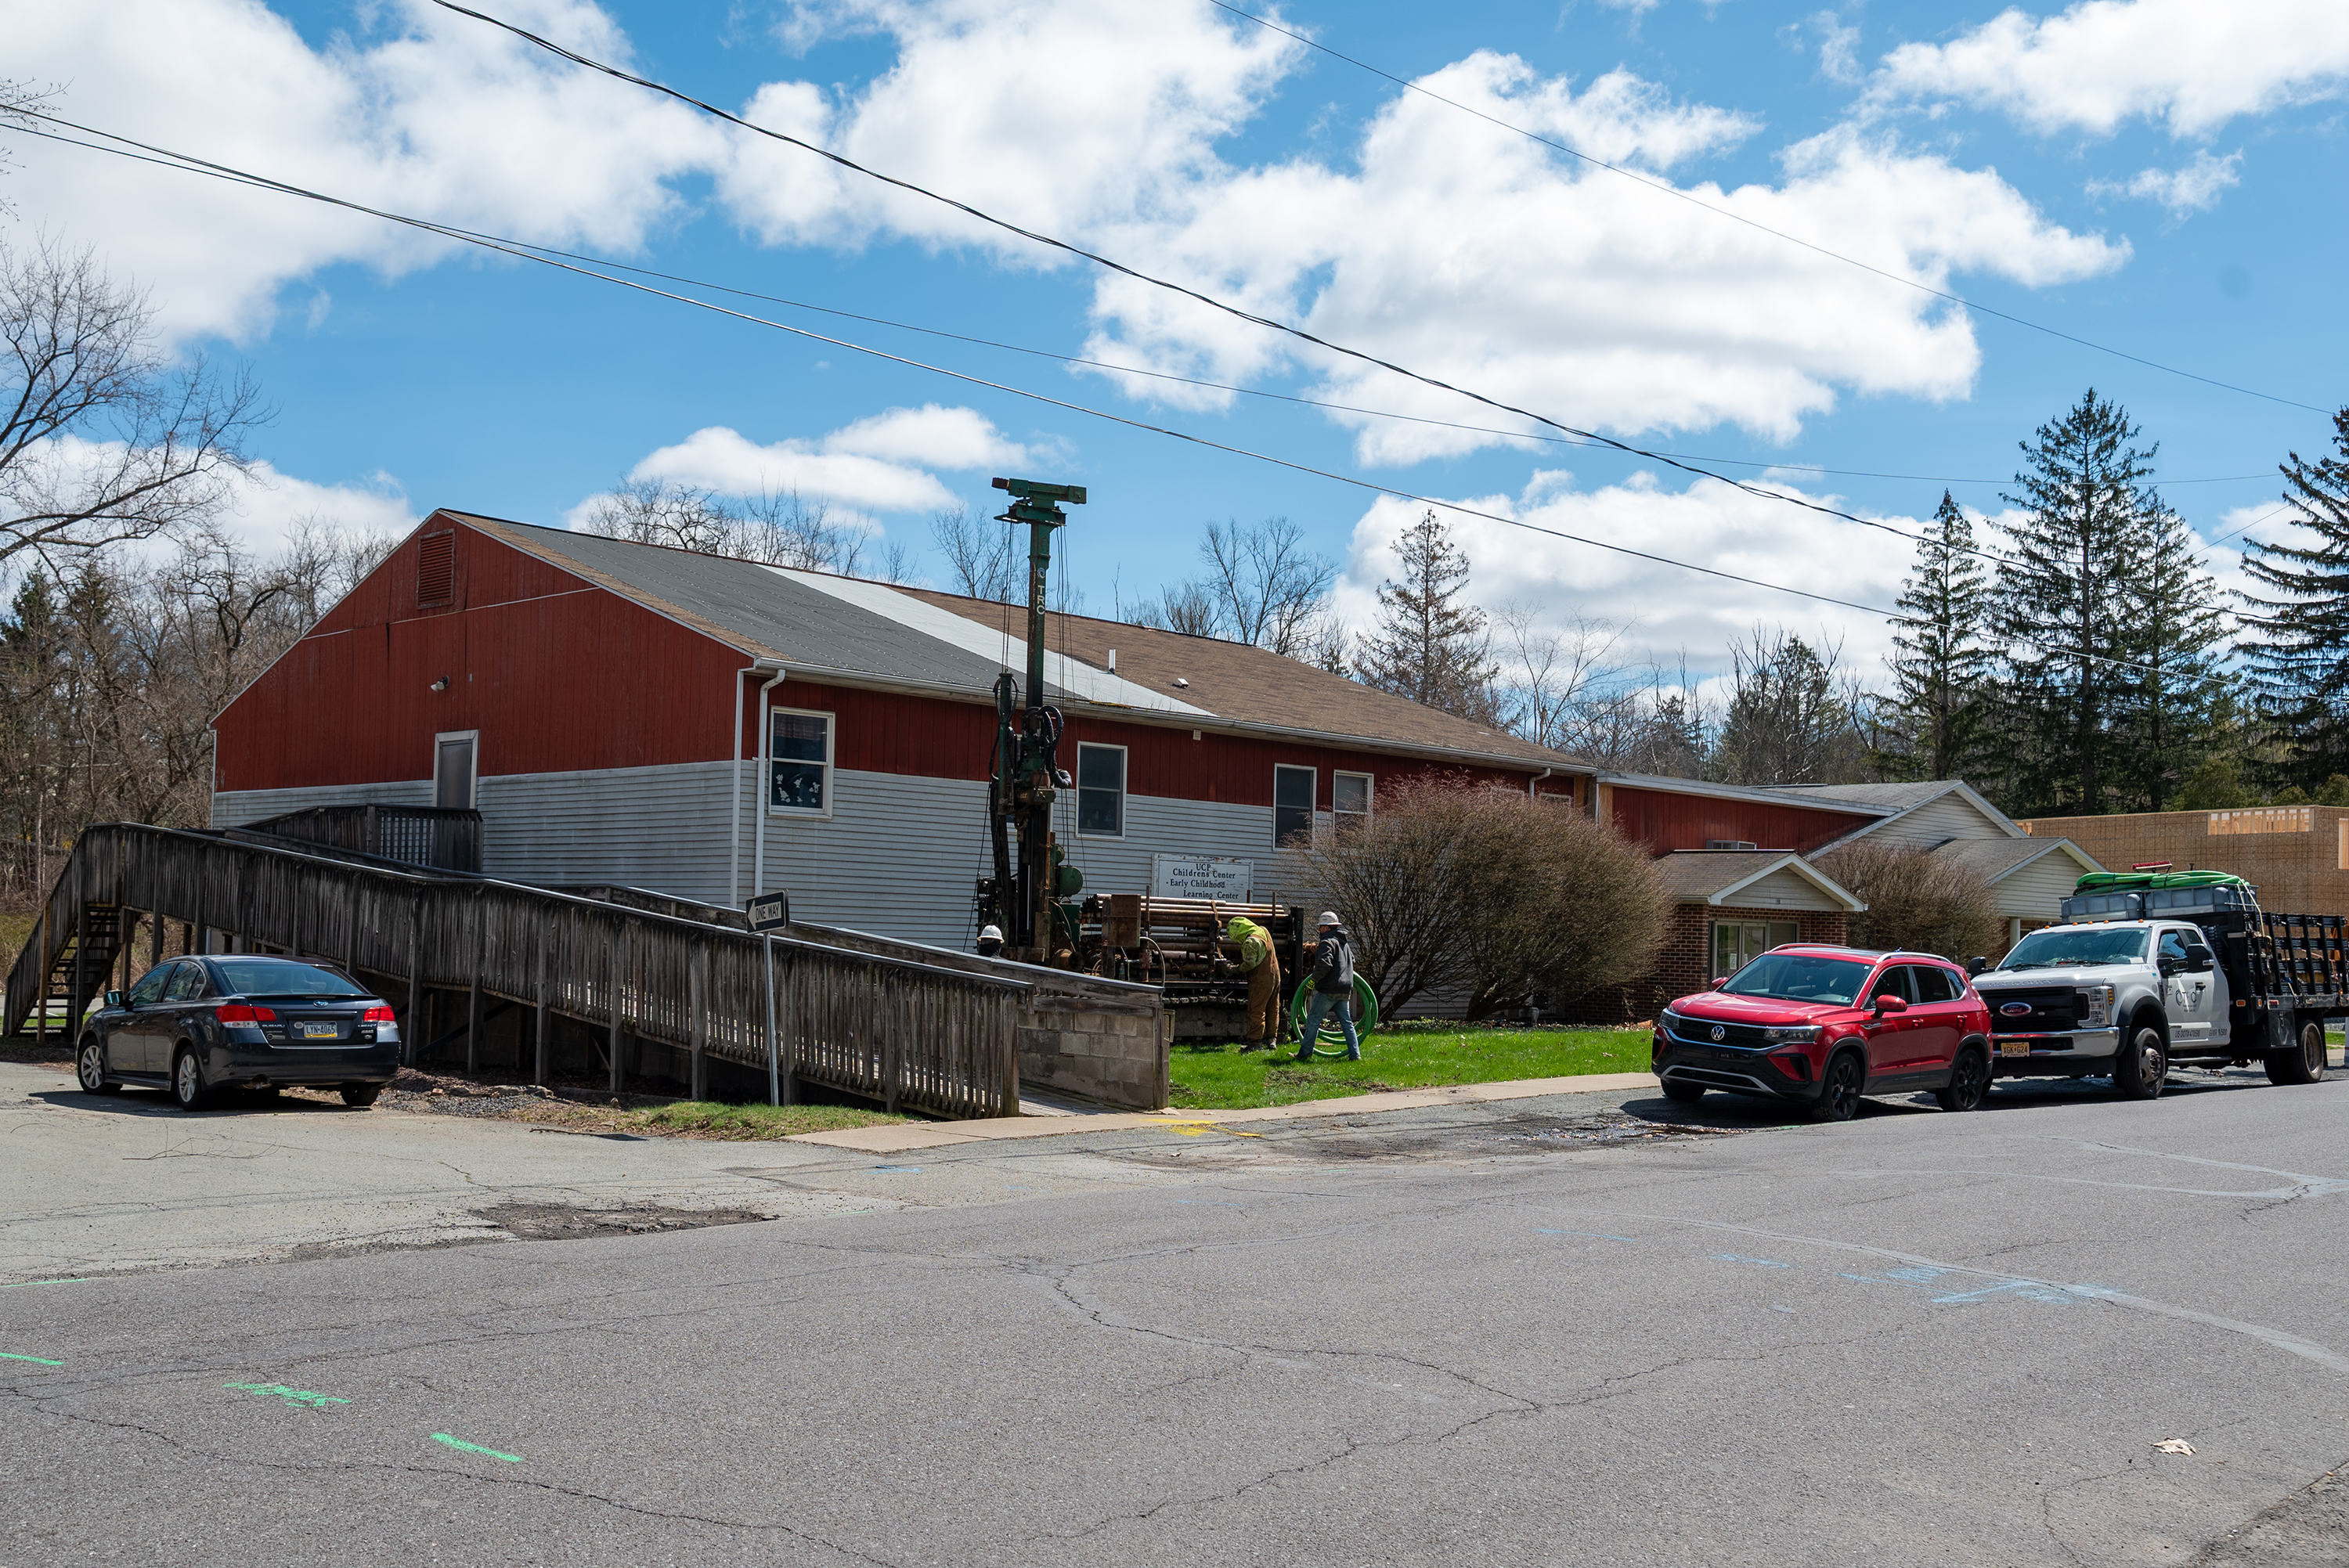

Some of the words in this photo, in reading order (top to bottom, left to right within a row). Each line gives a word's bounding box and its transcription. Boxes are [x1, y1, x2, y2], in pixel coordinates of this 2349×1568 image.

[1172, 868, 1210, 878] Childrens
[1213, 871, 1236, 879] Center
[1170, 879, 1189, 889] Early
[1190, 880, 1225, 889] Childhood
[1183, 890, 1213, 899] Learning
[1217, 891, 1239, 899] Center
[756, 907, 766, 921] ONE
[767, 903, 779, 918] WAY
